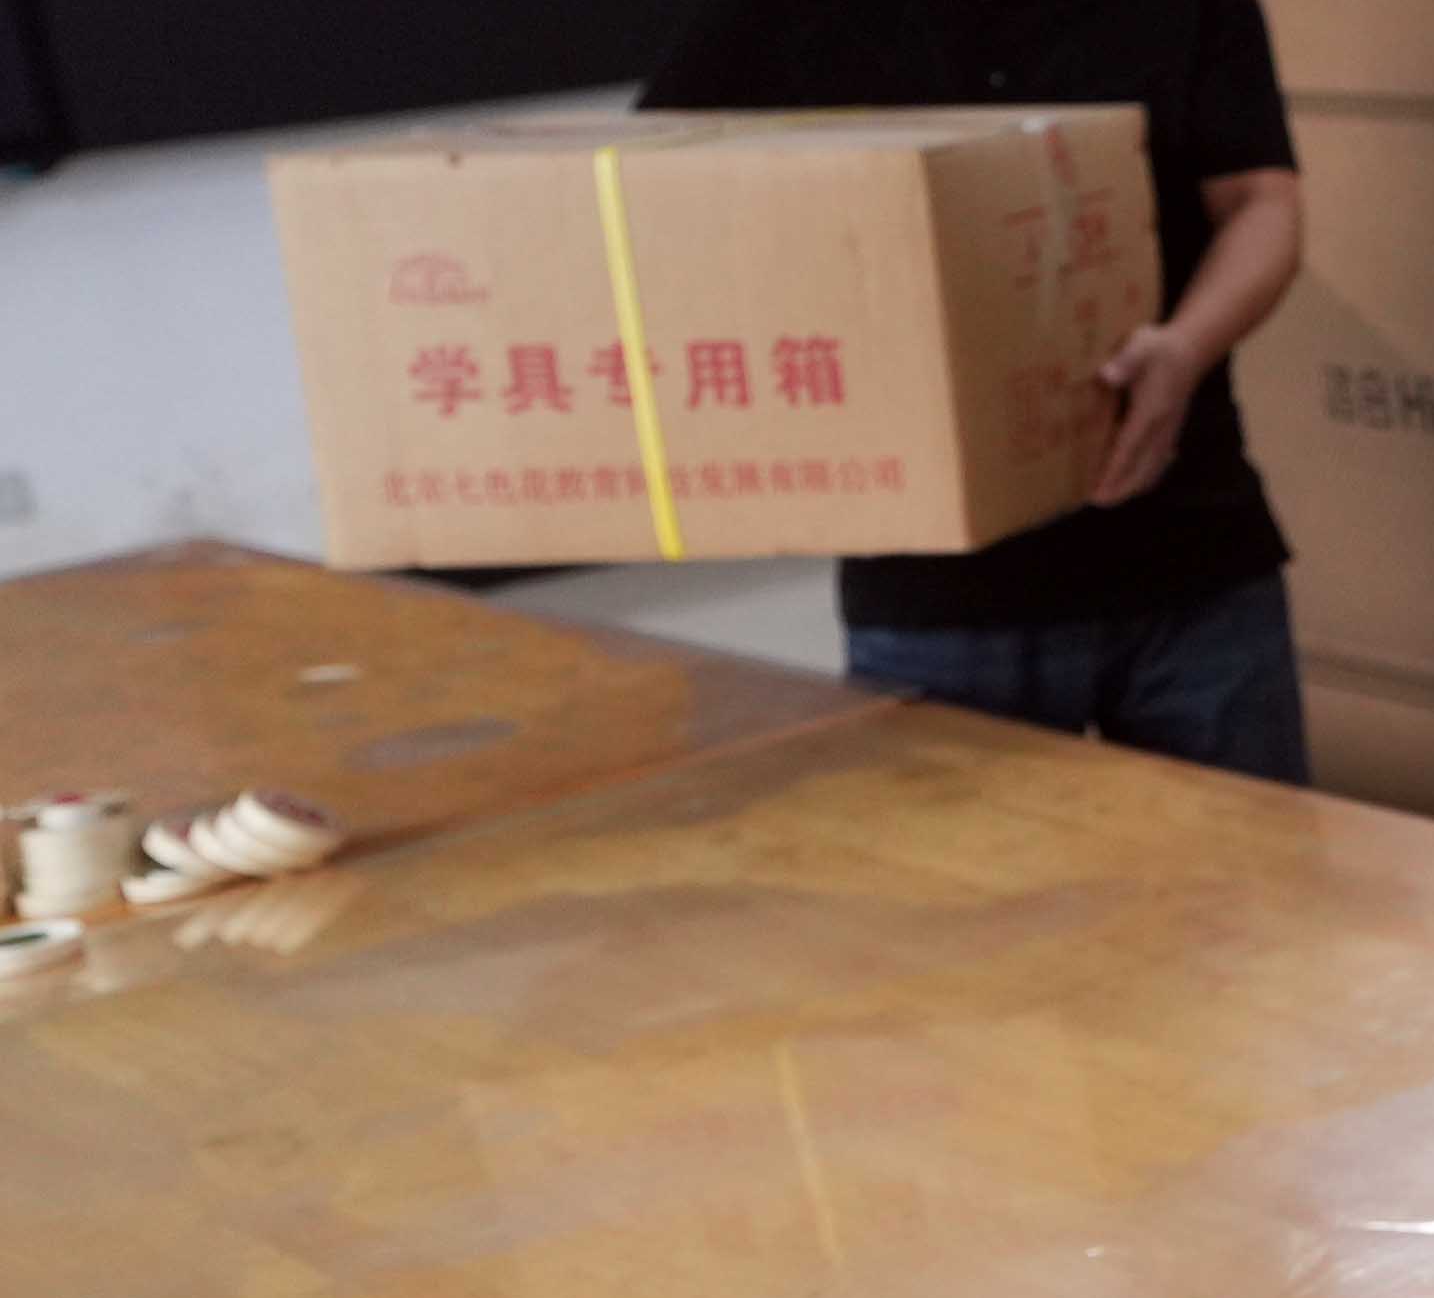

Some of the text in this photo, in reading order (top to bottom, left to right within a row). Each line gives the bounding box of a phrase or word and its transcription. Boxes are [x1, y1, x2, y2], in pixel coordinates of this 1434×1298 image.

[406, 335, 847, 417] 学具专用箱
